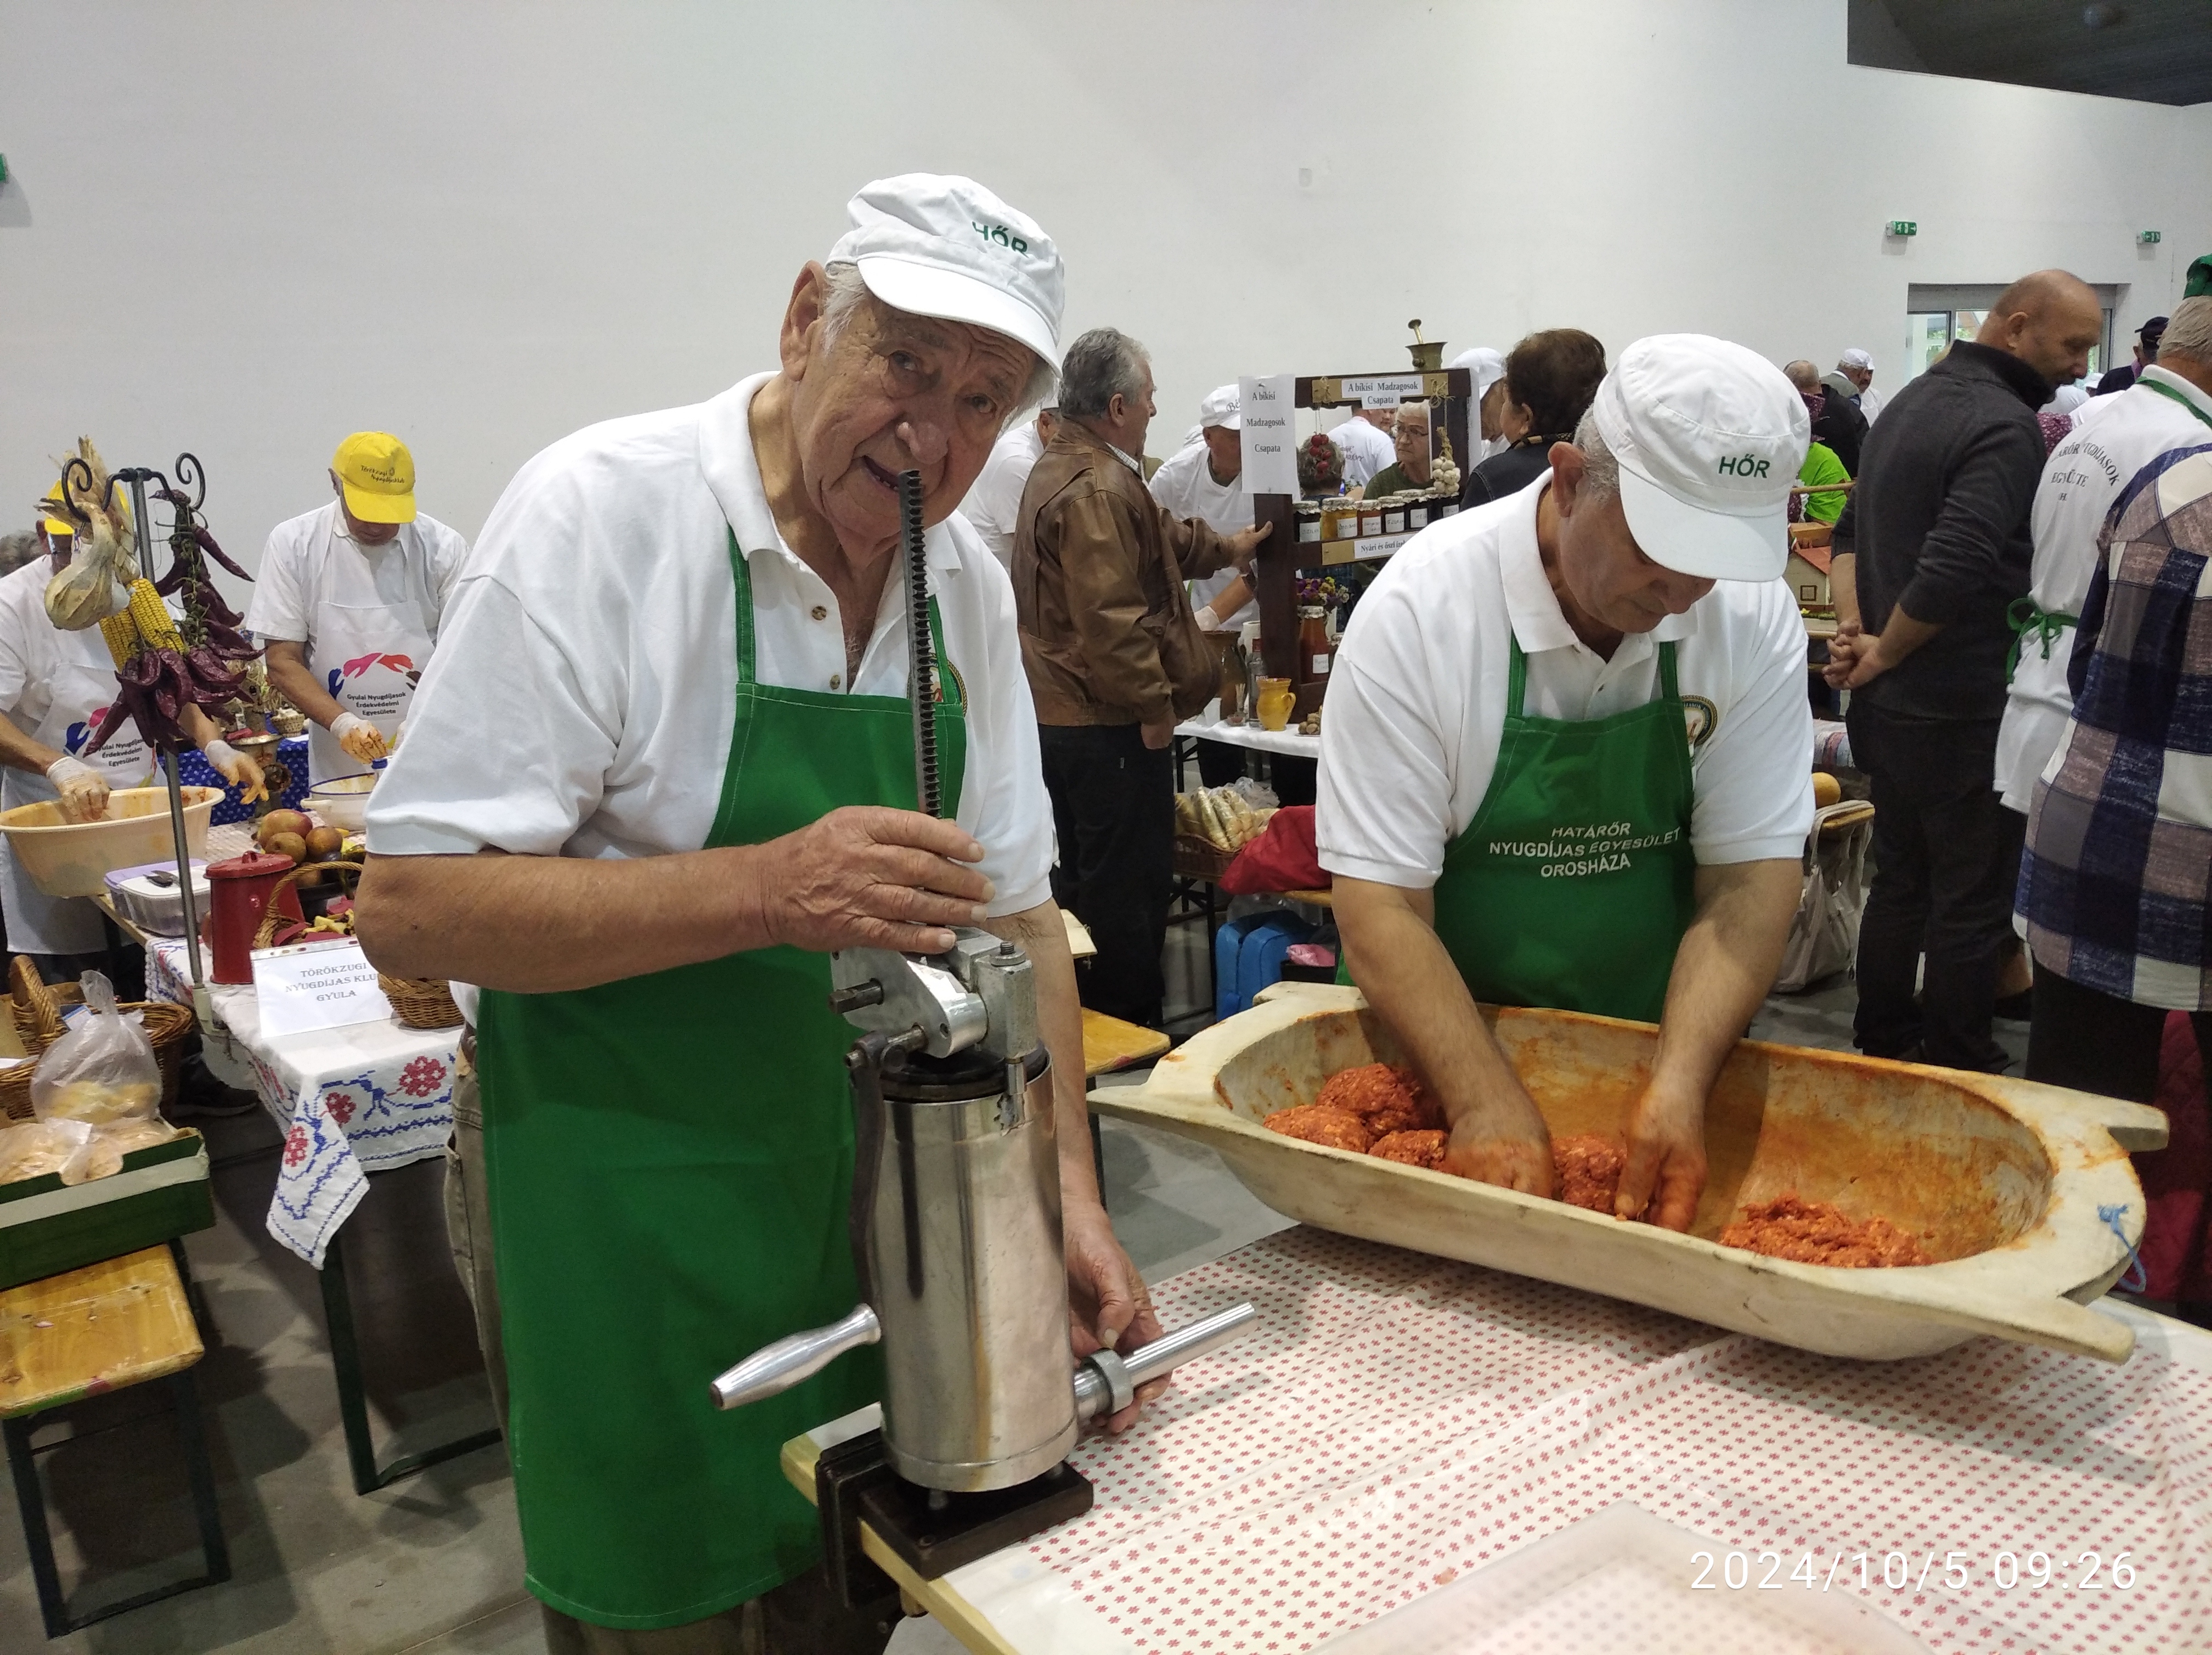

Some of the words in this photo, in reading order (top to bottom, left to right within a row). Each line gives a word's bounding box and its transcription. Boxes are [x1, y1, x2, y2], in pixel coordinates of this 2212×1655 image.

[1348, 383, 1354, 392] A
[1377, 381, 1418, 392] Madzagosok
[1252, 392, 1258, 401] A
[1367, 396, 1394, 406] Csapata
[1246, 417, 1286, 429] Madzagosok
[1254, 443, 1281, 455] Csapata
[1718, 453, 1770, 479] HŐR
[1361, 544, 1377, 554] Nyári
[1385, 541, 1395, 549] őszi
[368, 691, 407, 701] Nyugdíjasok
[101, 746, 143, 758] Érdekvédelmi
[108, 756, 140, 767] Egyesülete
[1551, 821, 1631, 839] HATÁRŐR
[1489, 840, 1585, 858] NYUGDÍJAS
[1589, 826, 1680, 854] EGYESÜLET
[1540, 852, 1632, 878] OROSHÁZA
[300, 962, 366, 977] TÖRÖKZUGI
[285, 977, 351, 993] NYUGDÍJAS
[354, 973, 377, 983] KLU
[317, 990, 357, 1001] GYULA
